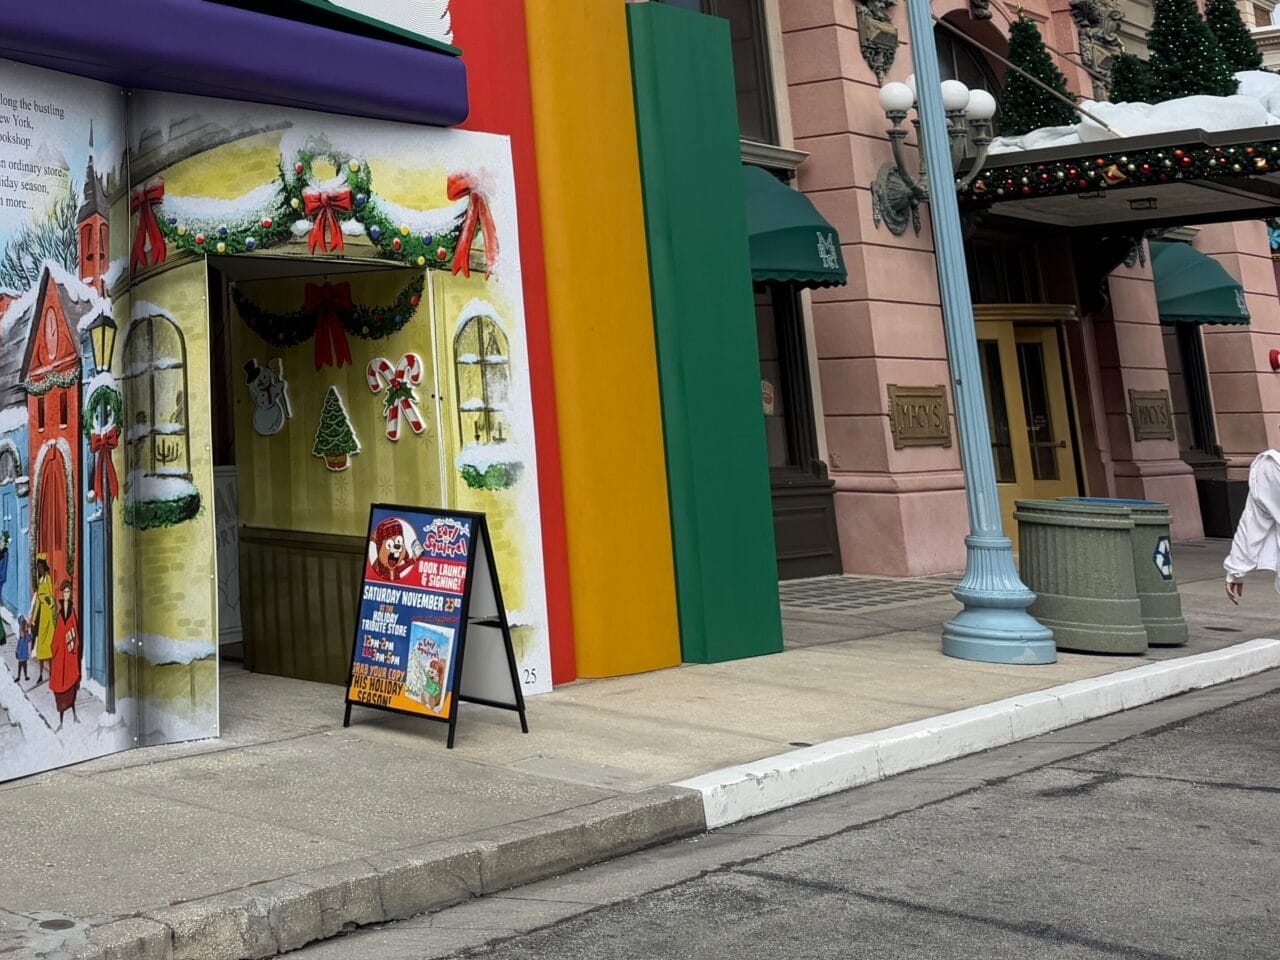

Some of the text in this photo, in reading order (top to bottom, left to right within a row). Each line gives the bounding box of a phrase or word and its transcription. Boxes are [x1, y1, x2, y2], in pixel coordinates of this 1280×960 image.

[20, 97, 32, 111] the
[33, 100, 65, 120] bustling
[12, 114, 34, 130] York,
[8, 159, 42, 176] ordinary
[43, 165, 65, 179] store.
[20, 181, 50, 195] season,
[5, 197, 34, 210] more...
[436, 524, 460, 541] Earl
[423, 533, 467, 557] Squirrel
[419, 560, 467, 579] BOOK LAUNCH
[428, 575, 462, 590] SIGNING!
[363, 585, 402, 604] SATURDAY
[402, 591, 444, 611] NOVEMBER
[372, 610, 399, 624] HOLIDAY
[362, 619, 408, 637] TRIBUTE STORE
[369, 666, 387, 678] YOUR
[387, 669, 406, 681] COPY
[524, 668, 537, 684] 25
[369, 677, 404, 696] HOLIDAY
